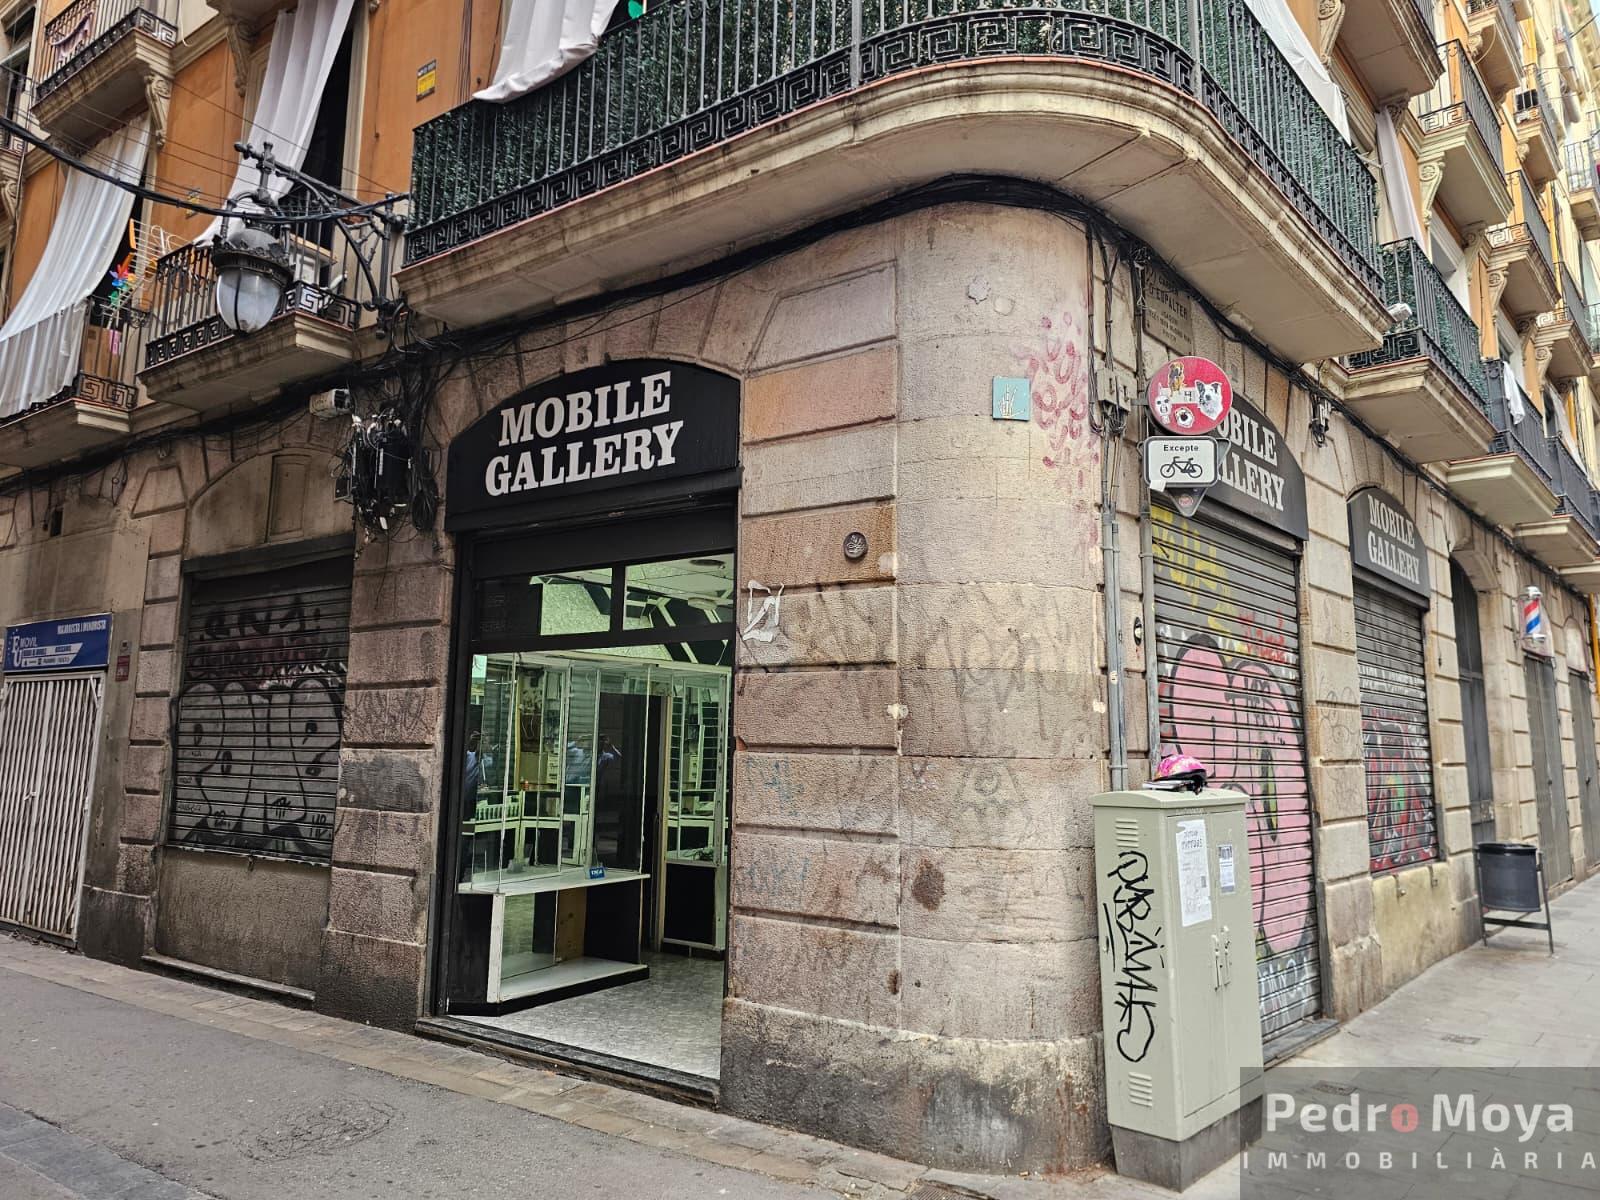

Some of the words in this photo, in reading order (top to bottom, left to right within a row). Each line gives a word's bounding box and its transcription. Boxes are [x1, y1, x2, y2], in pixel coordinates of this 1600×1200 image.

[498, 371, 671, 447] MOBILE
[1217, 407, 1277, 466] OBILE
[485, 420, 684, 497] GALLERY
[1163, 444, 1199, 453] Excepte
[1367, 494, 1416, 549] MOBILE
[1368, 530, 1420, 584] GALLERY
